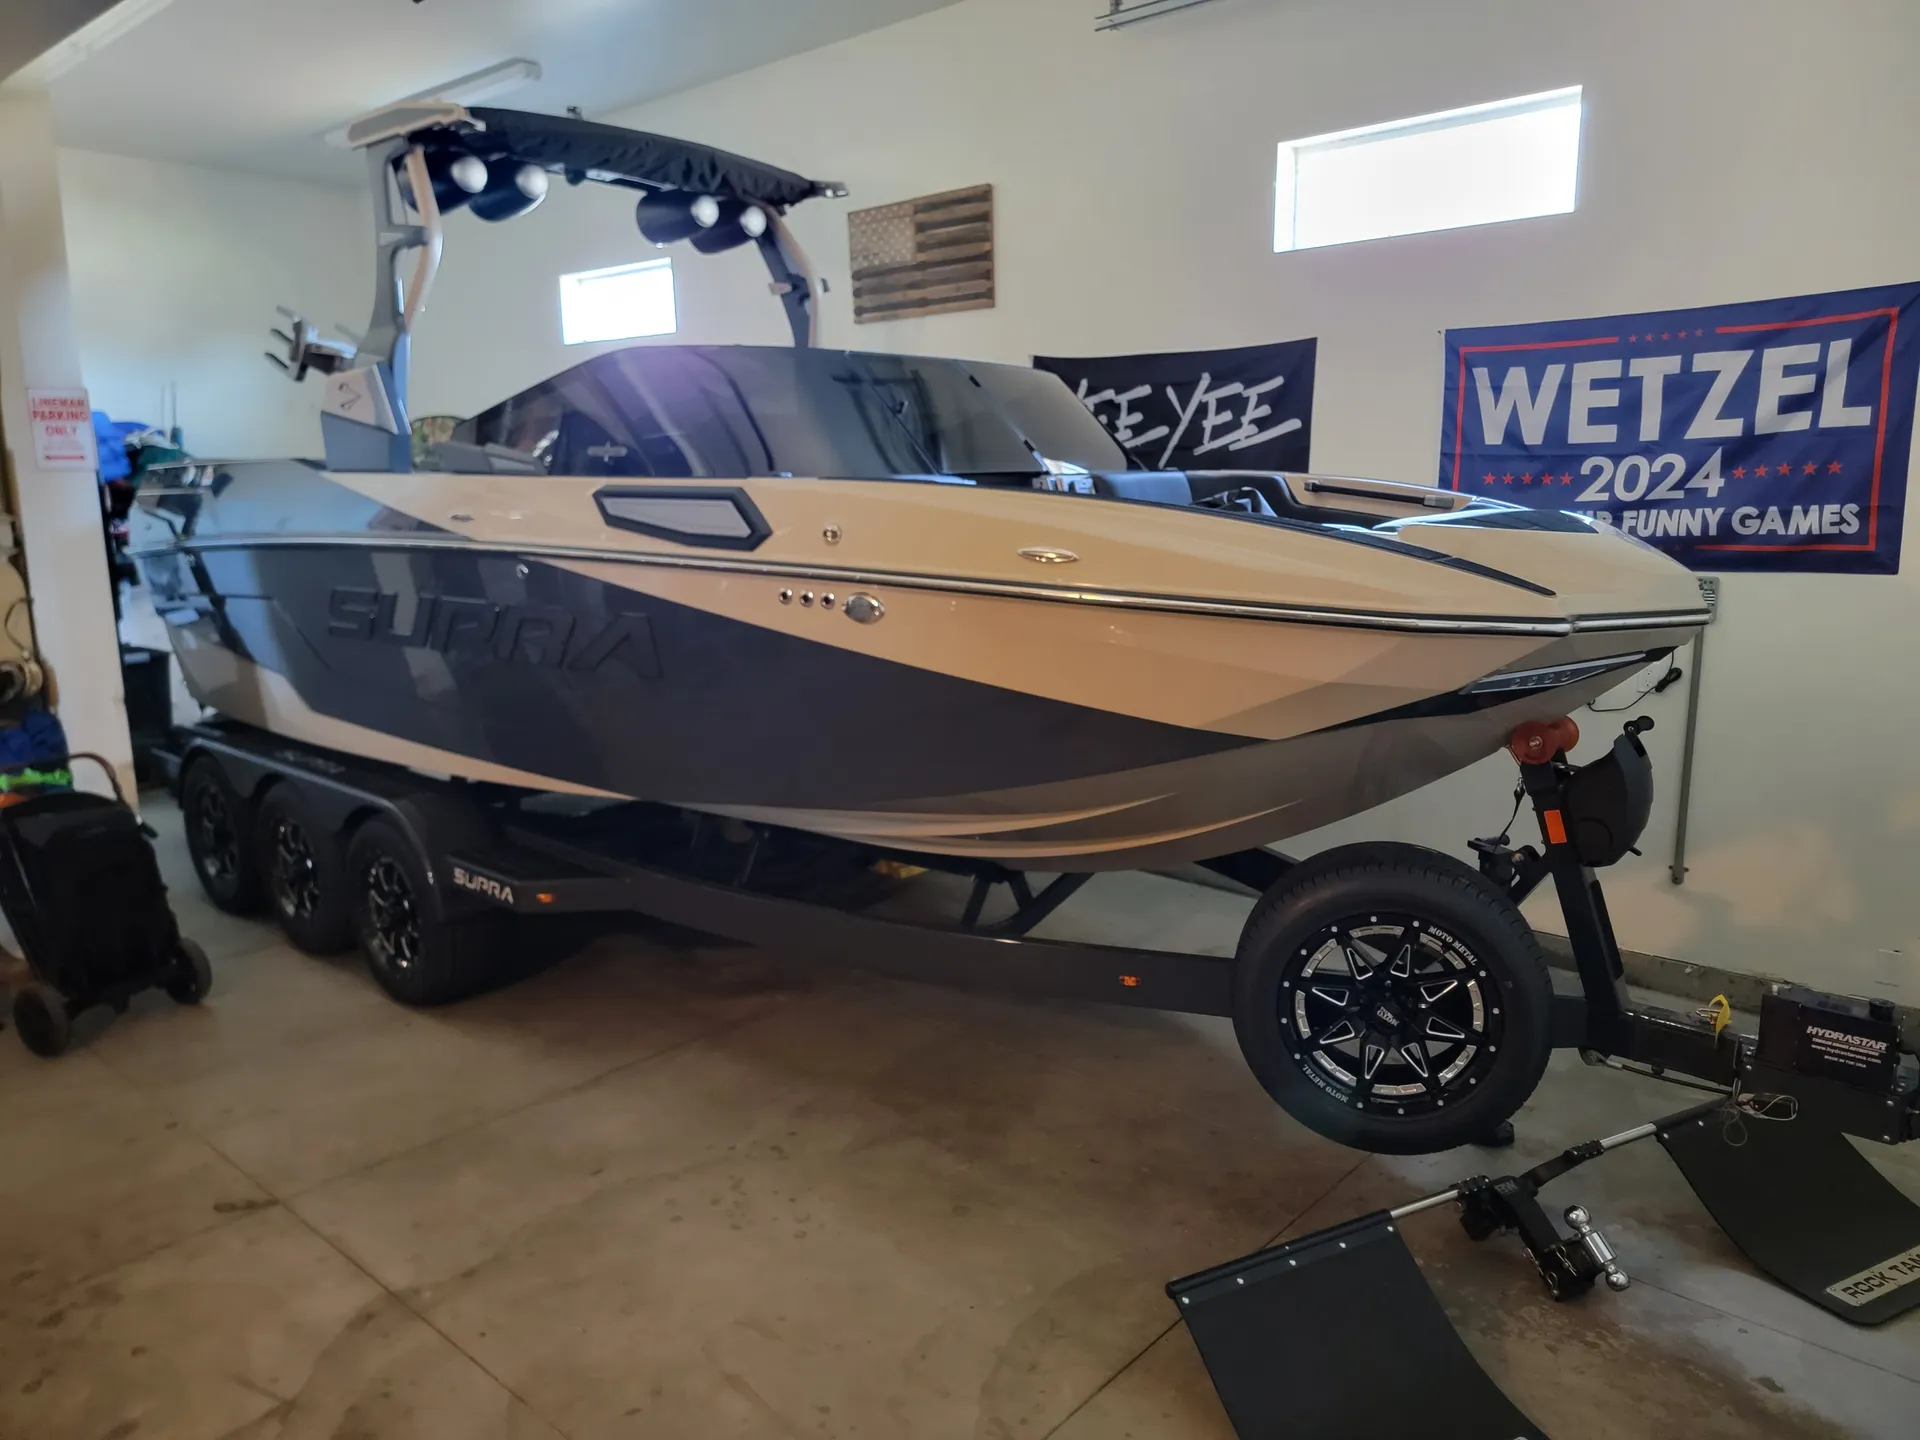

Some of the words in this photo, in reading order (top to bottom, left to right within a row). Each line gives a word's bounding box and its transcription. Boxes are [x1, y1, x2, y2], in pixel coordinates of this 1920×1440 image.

[1472, 337, 1874, 446] WETZEL
[32, 409, 89, 421] PARKING
[46, 425, 77, 436] ONLY
[1158, 372, 1302, 470] YEE
[1575, 446, 1725, 502] 2024
[1622, 506, 1726, 538] FUNNY
[1731, 503, 1861, 536] GAMES
[328, 586, 665, 681] SUPRA
[453, 867, 515, 905] SUPRA
[1427, 925, 1453, 943] MOTO
[1451, 940, 1478, 966] METAL
[1806, 1025, 1888, 1051] HYDRASTAR
[1302, 1064, 1327, 1089] METAL
[1325, 1086, 1349, 1103] MOTO
[1841, 1271, 1897, 1299] ROCK
